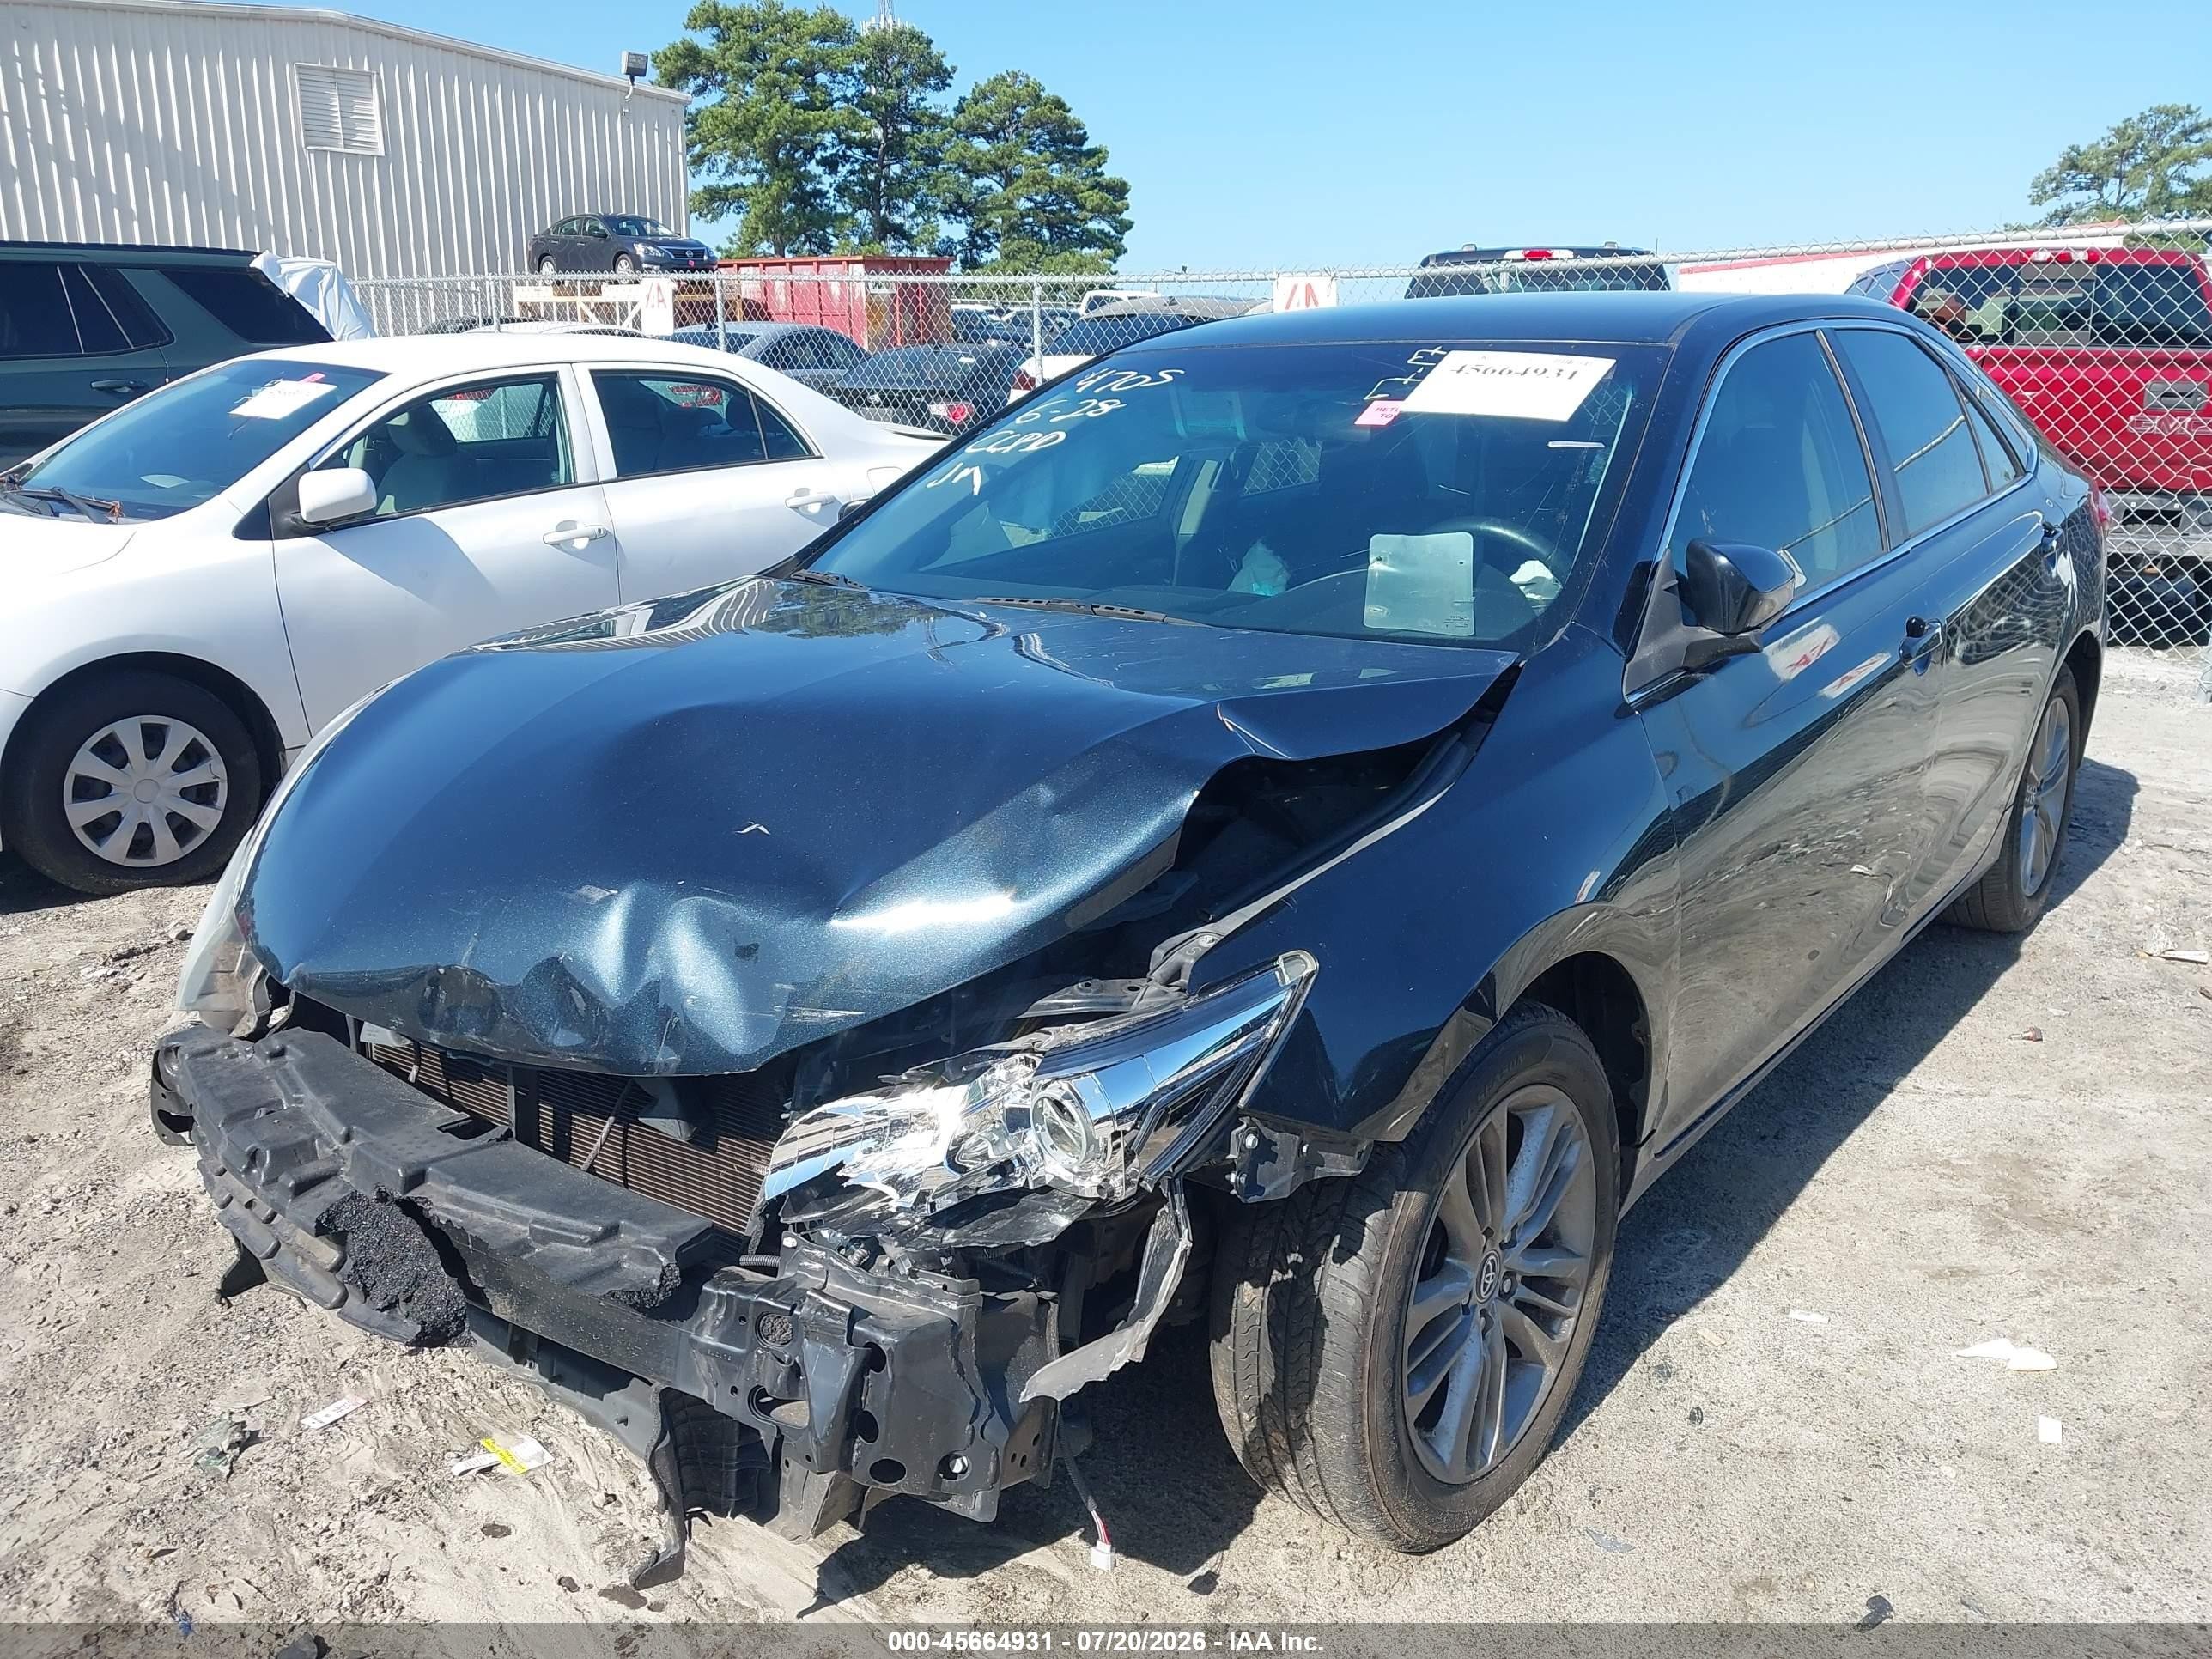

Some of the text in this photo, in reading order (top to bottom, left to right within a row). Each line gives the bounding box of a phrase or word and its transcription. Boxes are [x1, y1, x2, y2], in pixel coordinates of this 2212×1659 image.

[1450, 363, 1578, 380] 45664931
[1015, 398, 1127, 424] 6-28
[2127, 415, 2212, 435] GMC
